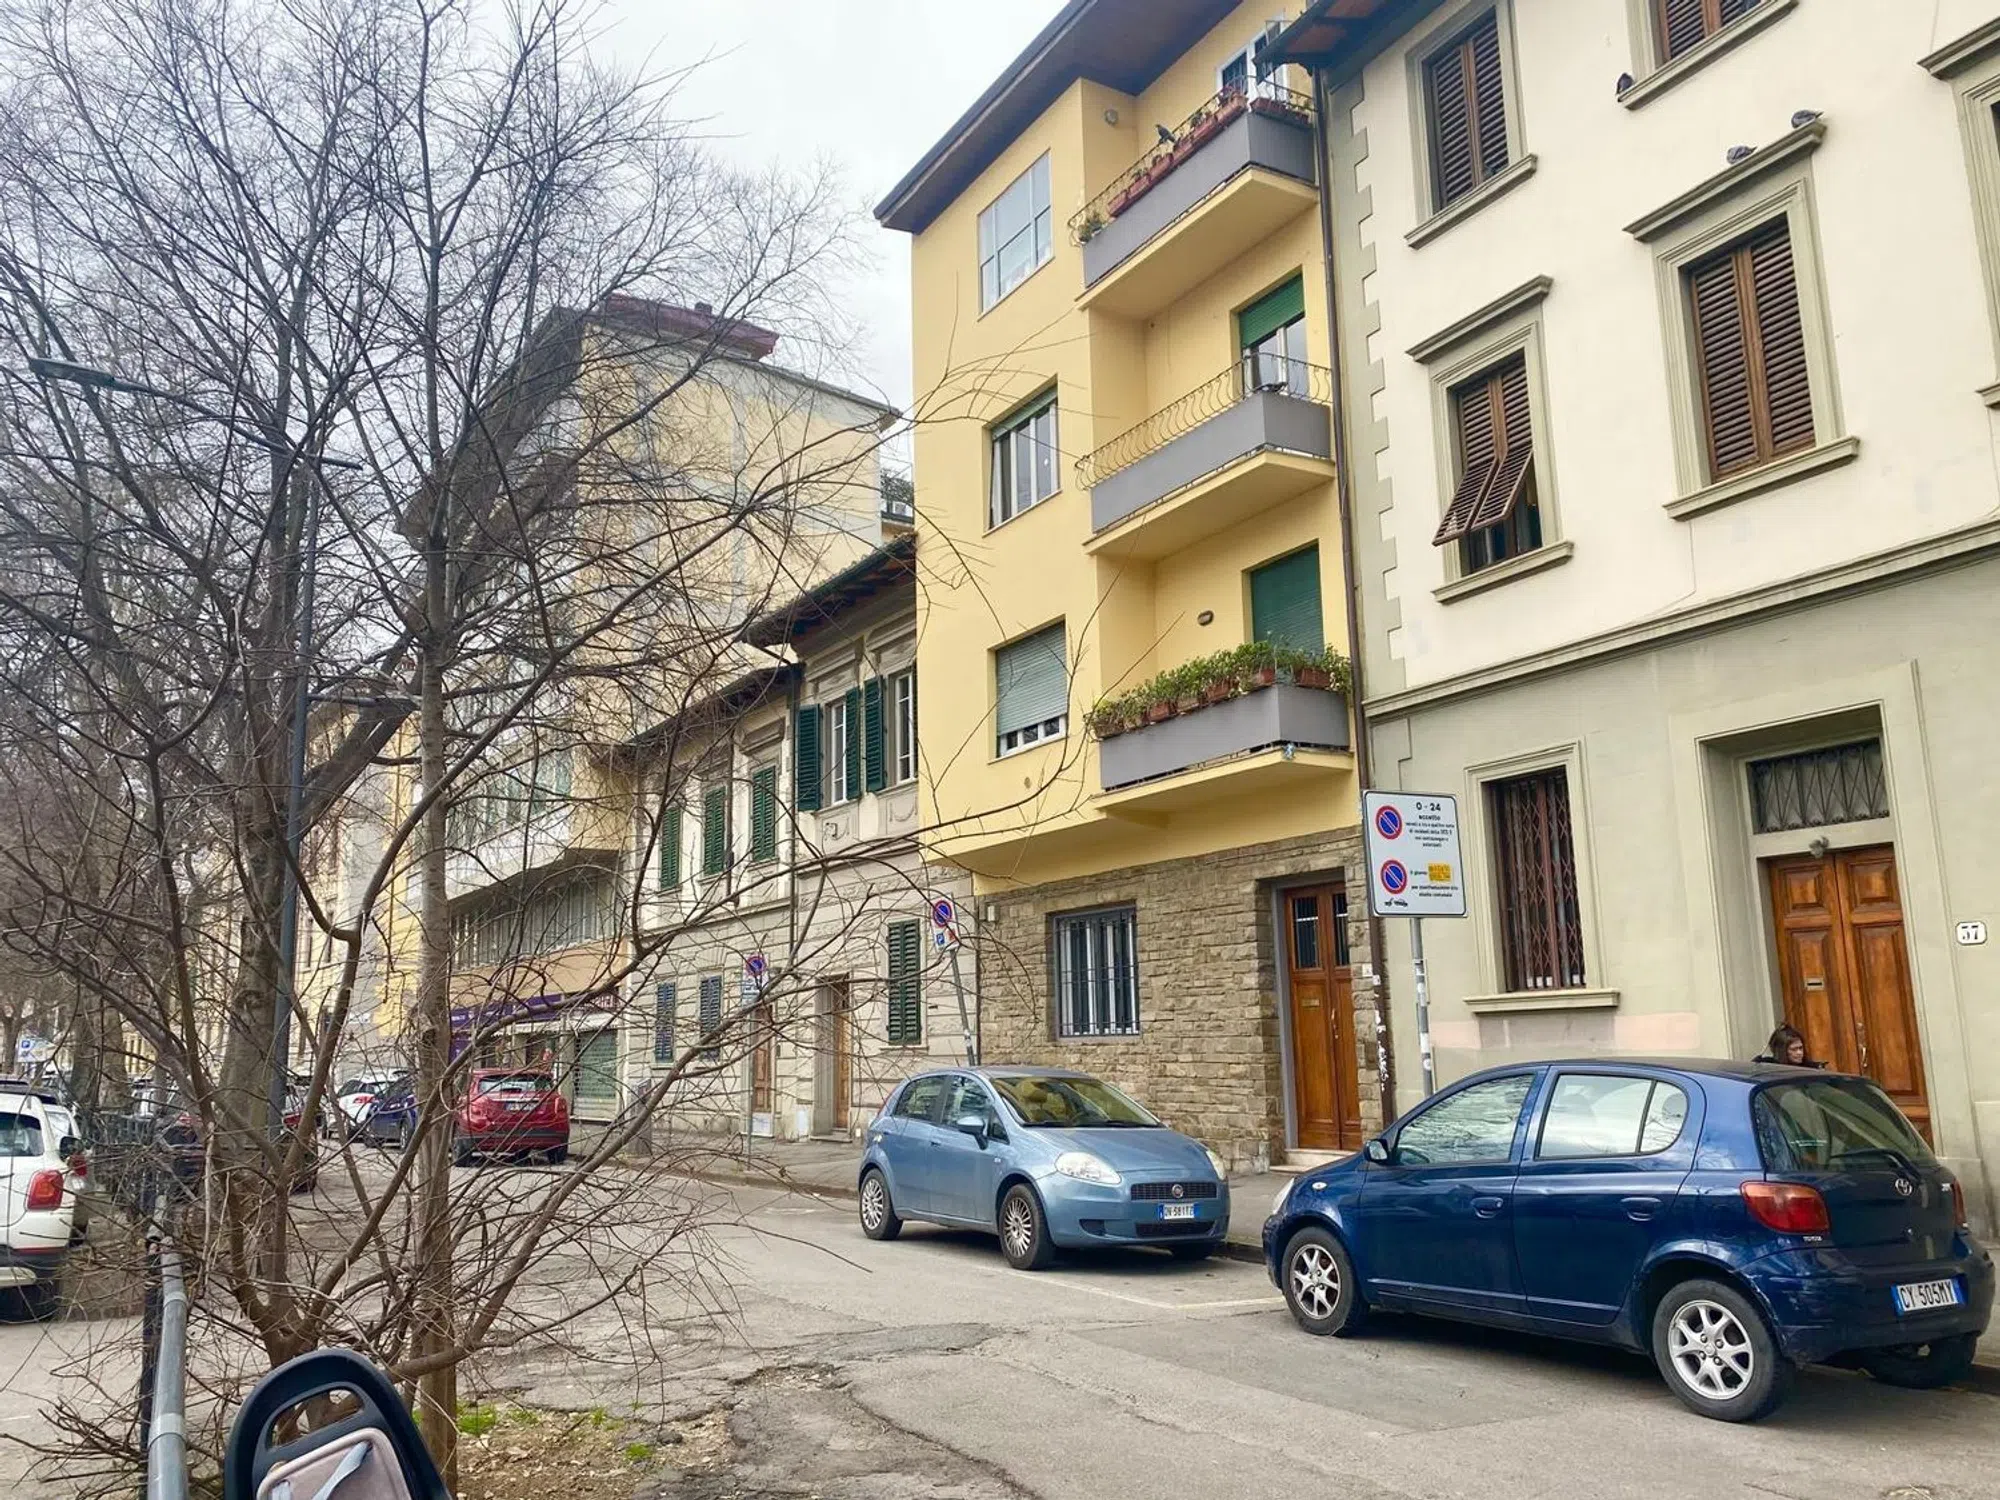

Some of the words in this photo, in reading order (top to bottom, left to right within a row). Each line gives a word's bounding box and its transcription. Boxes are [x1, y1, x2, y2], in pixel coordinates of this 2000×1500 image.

[1416, 802, 1422, 811] 0
[1429, 803, 1441, 812] 24
[1961, 925, 1979, 940] 57
[1900, 1285, 1916, 1309] CY
[1917, 1281, 1955, 1306] 505MY
